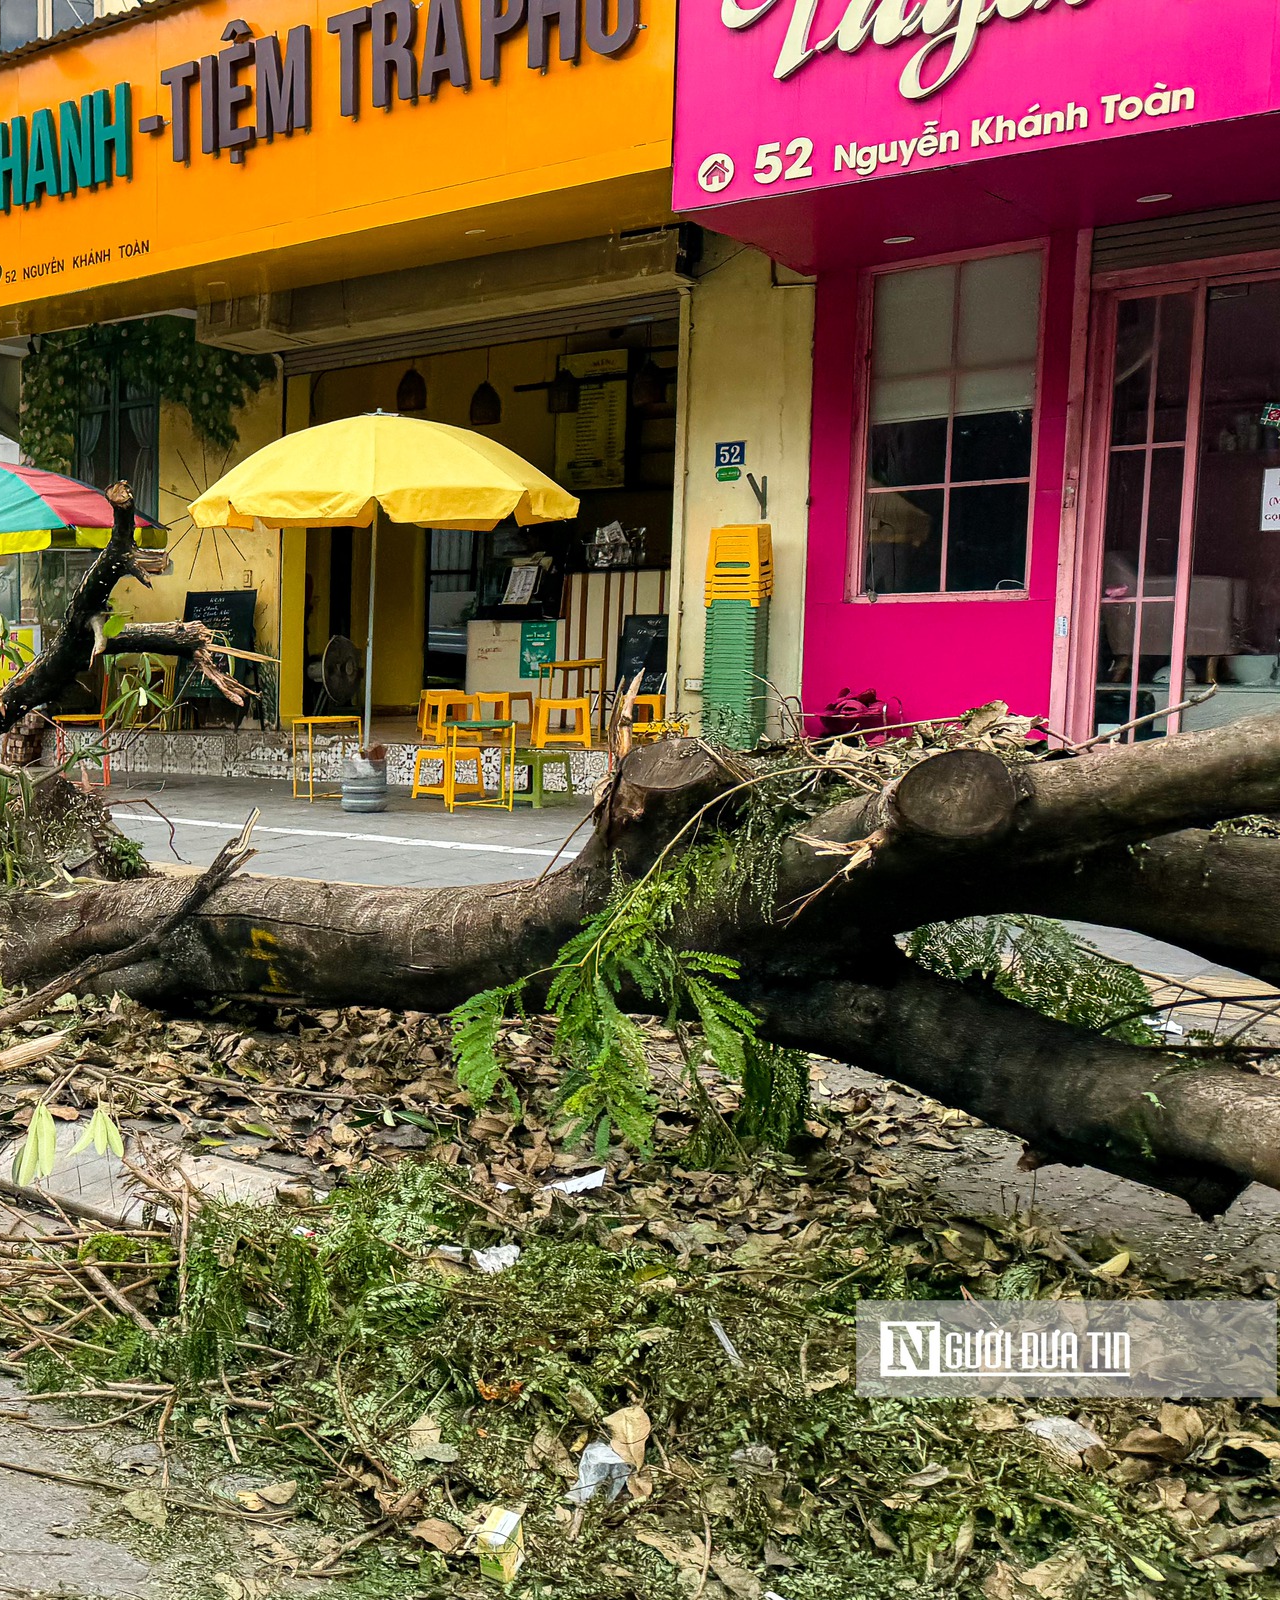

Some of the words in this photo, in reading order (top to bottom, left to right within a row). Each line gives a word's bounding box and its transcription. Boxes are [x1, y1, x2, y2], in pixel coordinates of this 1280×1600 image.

[160, 18, 312, 165] TIỆM
[753, 135, 814, 185] 52
[834, 119, 959, 175] Nguyễn
[970, 101, 1089, 148] Khánh
[1100, 81, 1196, 125] Toàn
[5, 270, 17, 284] 52
[73, 248, 111, 269] KHÁNH
[118, 239, 150, 259] TOÀN
[720, 445, 740, 464] 52
